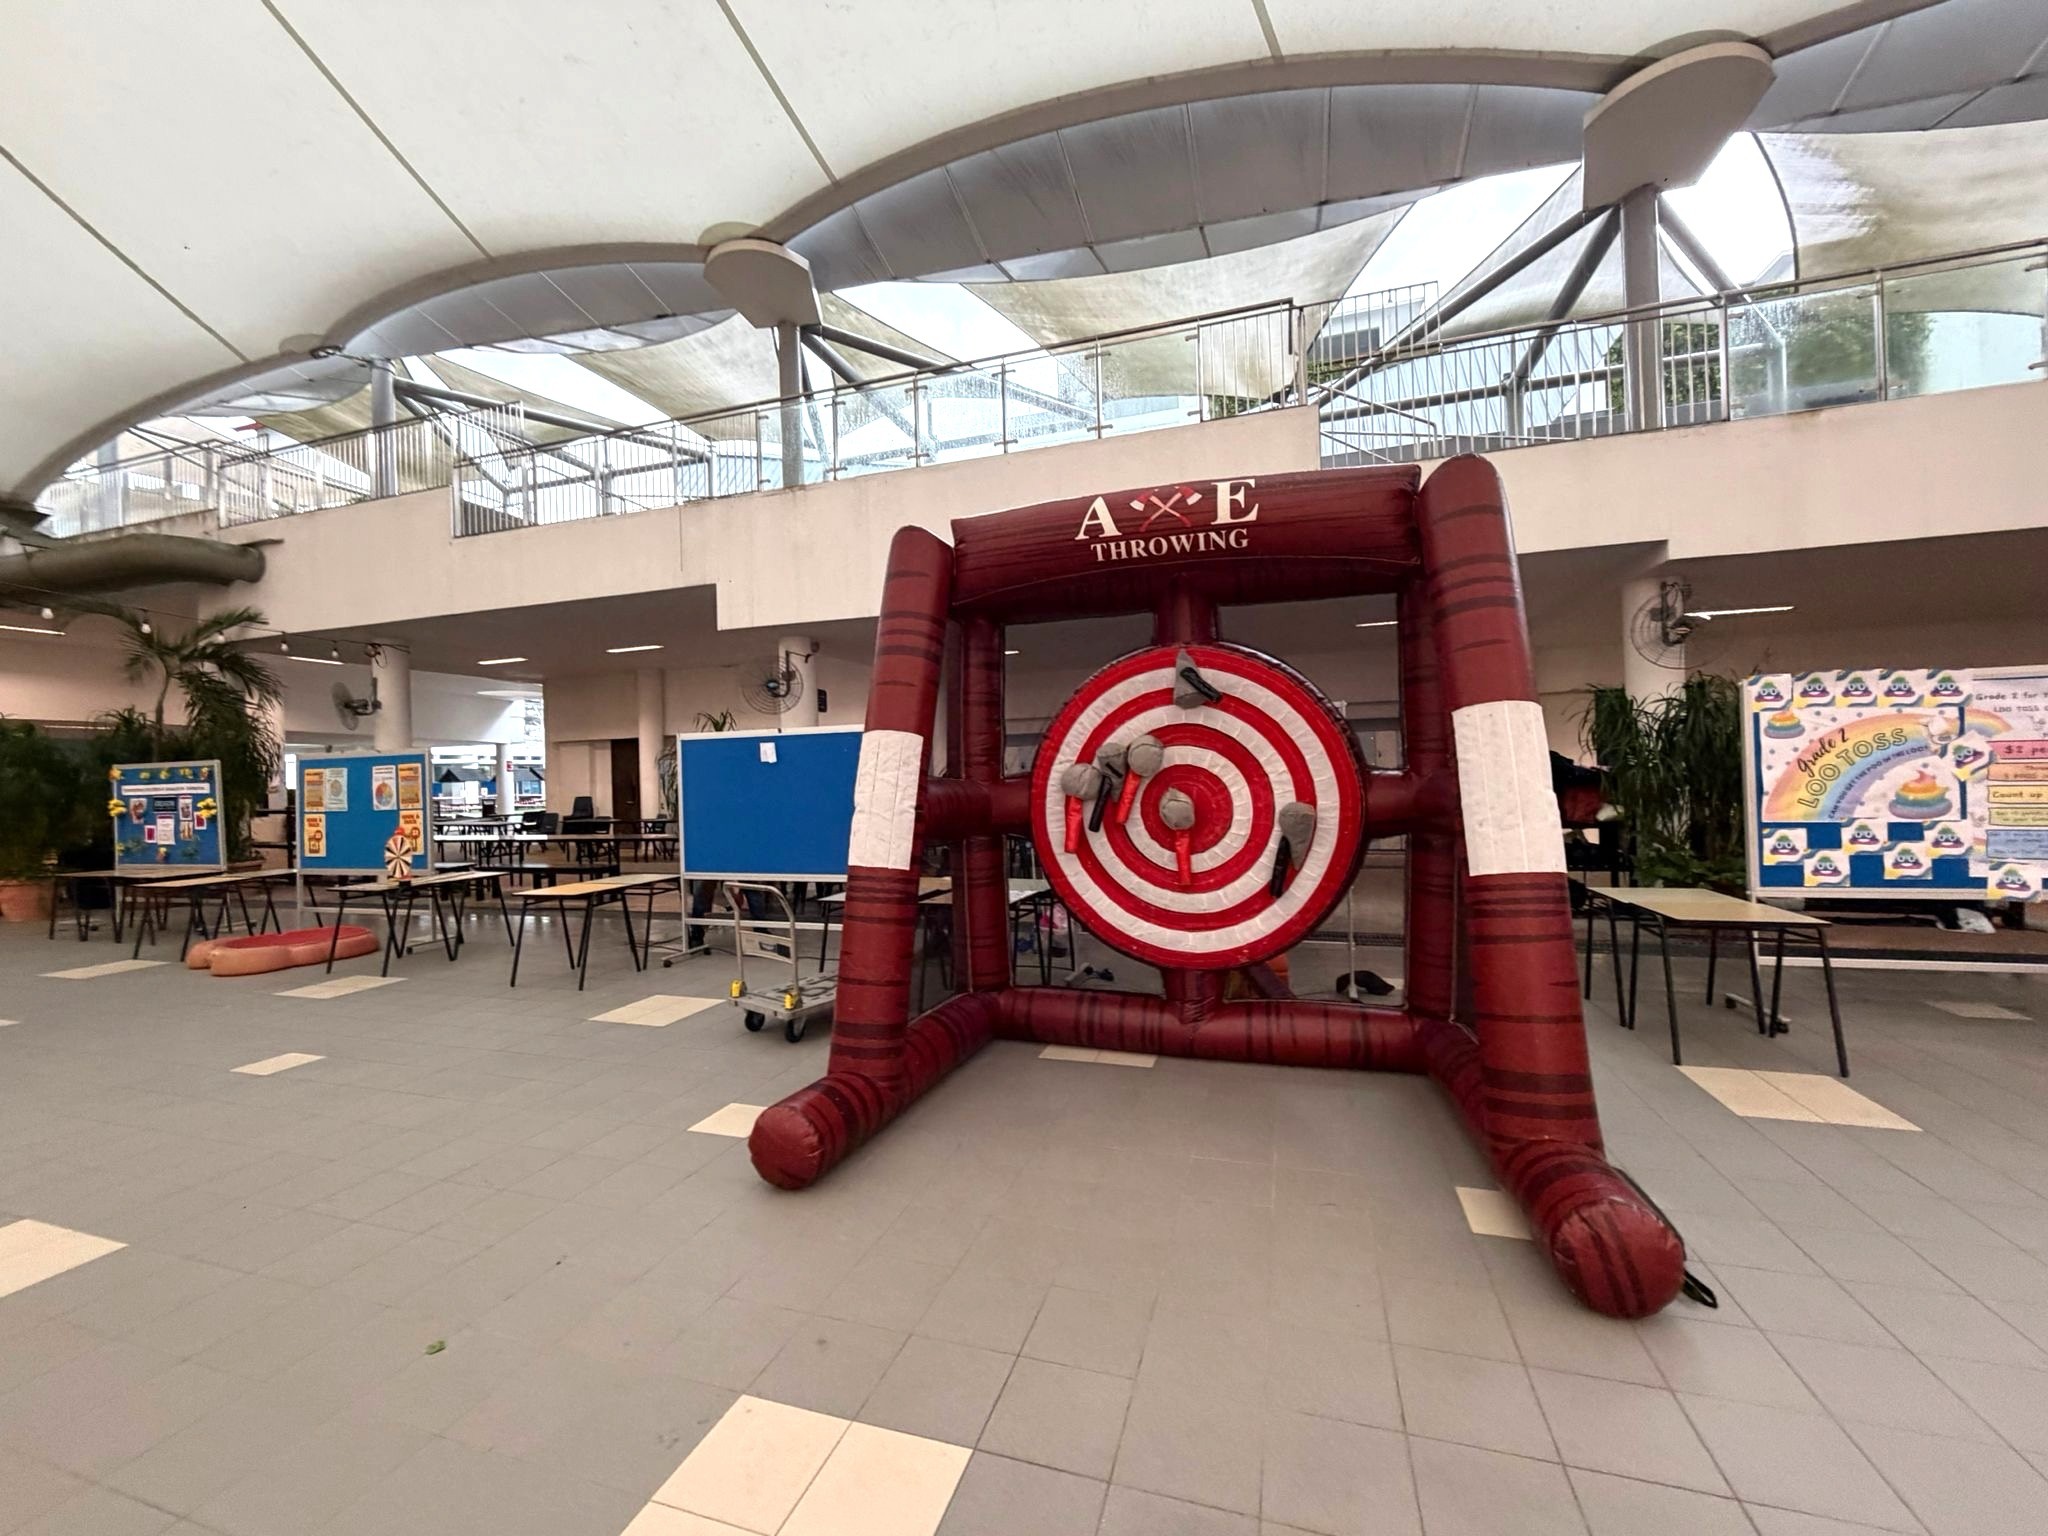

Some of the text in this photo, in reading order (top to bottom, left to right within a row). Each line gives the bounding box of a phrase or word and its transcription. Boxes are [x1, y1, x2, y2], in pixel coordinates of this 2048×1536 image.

[1090, 528, 1249, 562] THROWING
[1975, 692, 2006, 701] Grade
[2023, 691, 2038, 699] for
[1838, 727, 1849, 743] 2
[2031, 747, 2048, 756] pe
[1797, 728, 1908, 809] LOO TOSS
